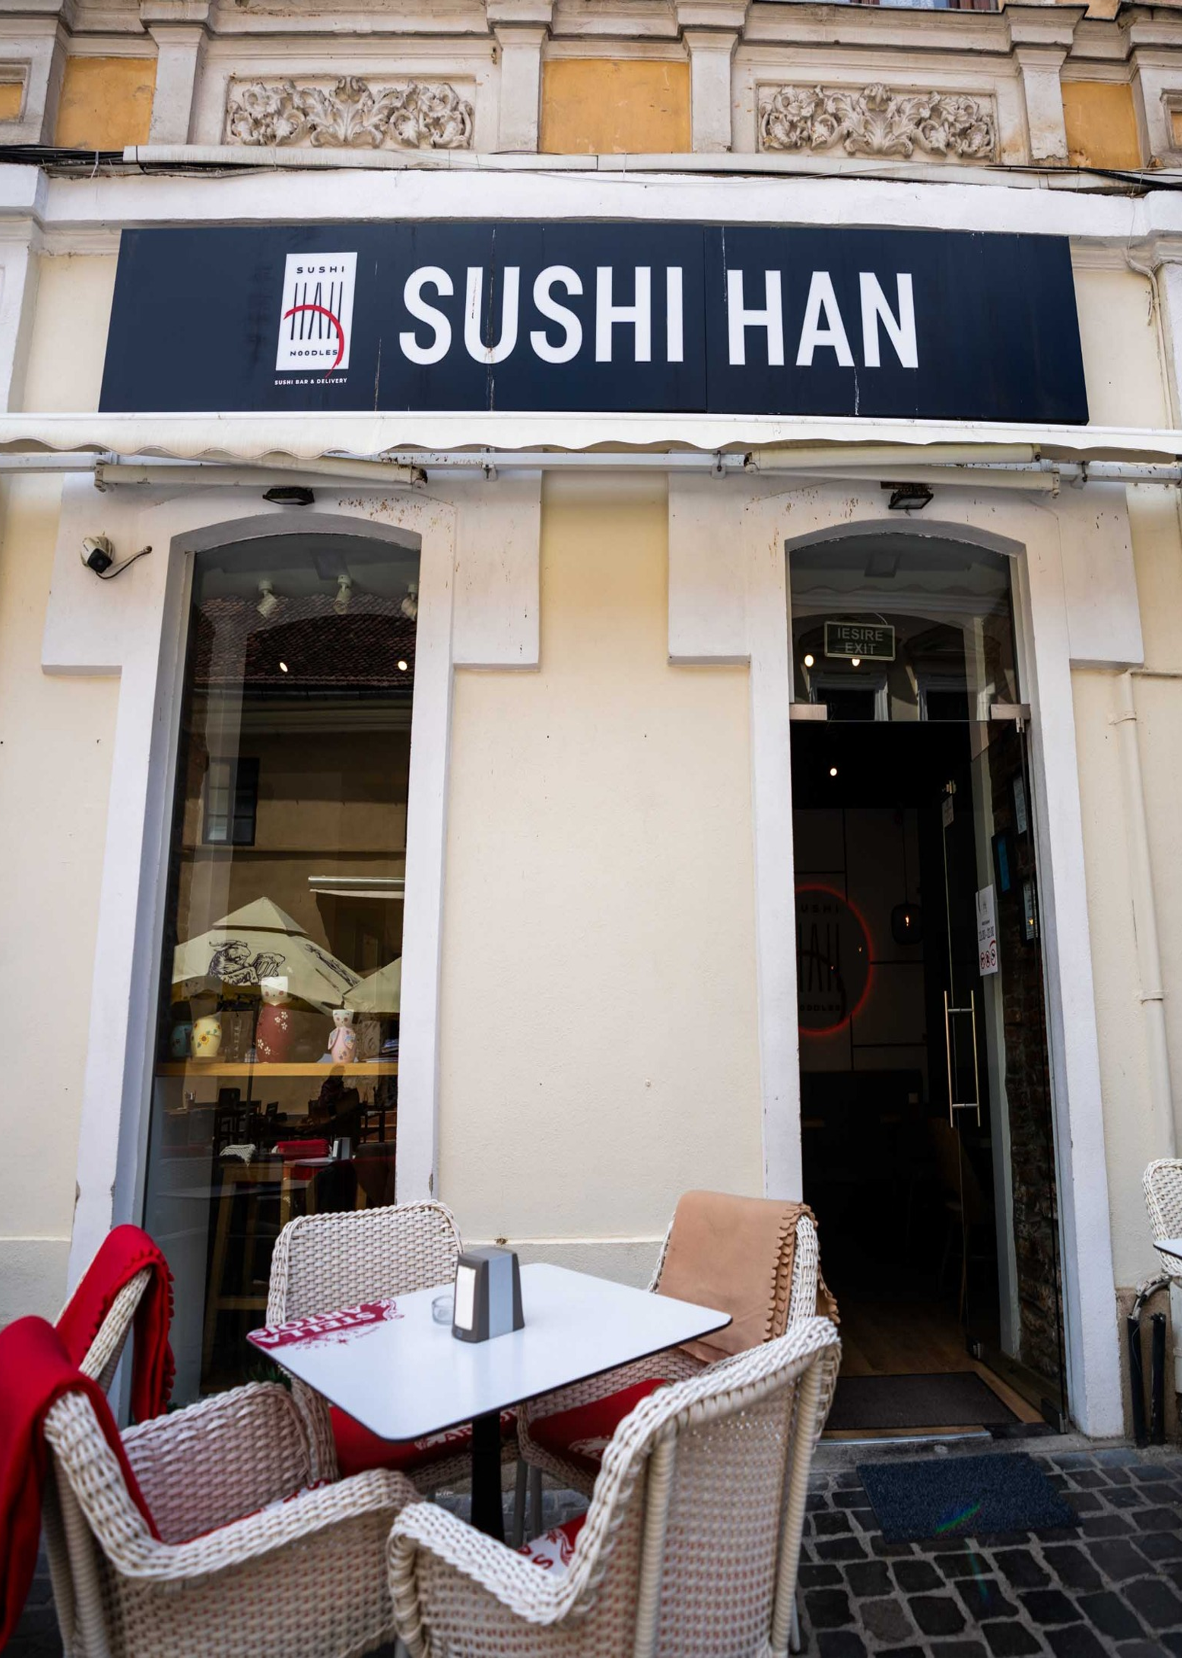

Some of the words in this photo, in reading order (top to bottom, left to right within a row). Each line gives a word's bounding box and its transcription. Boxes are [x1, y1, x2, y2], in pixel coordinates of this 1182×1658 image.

[296, 265, 345, 274] SUSHI
[399, 265, 684, 365] SUSHI
[727, 269, 919, 368] HAN
[289, 349, 338, 357] NOODLES
[837, 627, 884, 642] IESIRE
[844, 642, 877, 655] EXIT
[800, 903, 840, 914] USHI
[799, 1004, 841, 1012] OODLES
[249, 1305, 361, 1338] ARTOIS
[257, 1311, 376, 1344] STELLA
